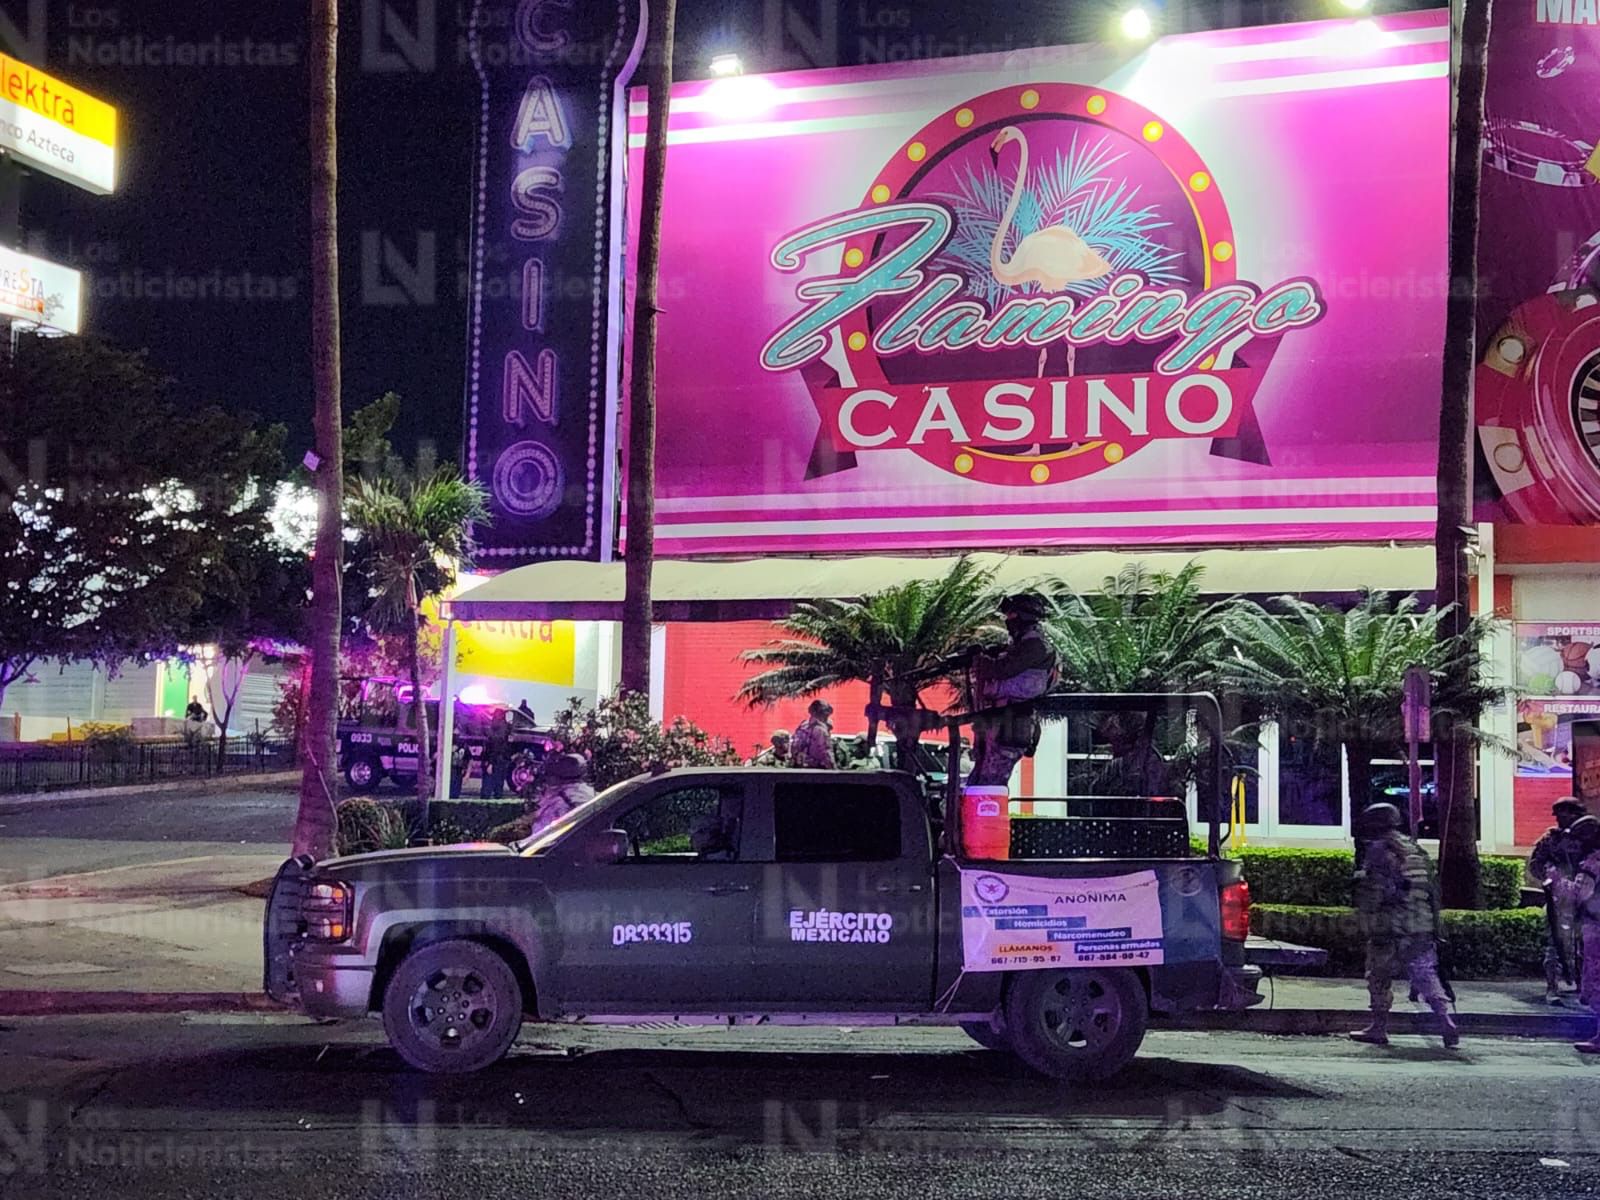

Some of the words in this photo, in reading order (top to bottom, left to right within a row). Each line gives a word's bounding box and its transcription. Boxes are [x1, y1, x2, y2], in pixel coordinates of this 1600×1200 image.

[1536, 0, 1600, 25] MA
[26, 129, 75, 163] Azteca
[492, 0, 574, 516] CASINO
[758, 202, 1322, 375] Flamingo
[837, 373, 1234, 446] CASINO
[789, 908, 893, 930] EJÉRCITO
[1013, 919, 1068, 928] Homicidios
[791, 928, 891, 943] MEXICANO
[1053, 930, 1127, 940] Narcomenudeo
[1077, 943, 1119, 952] Personas
